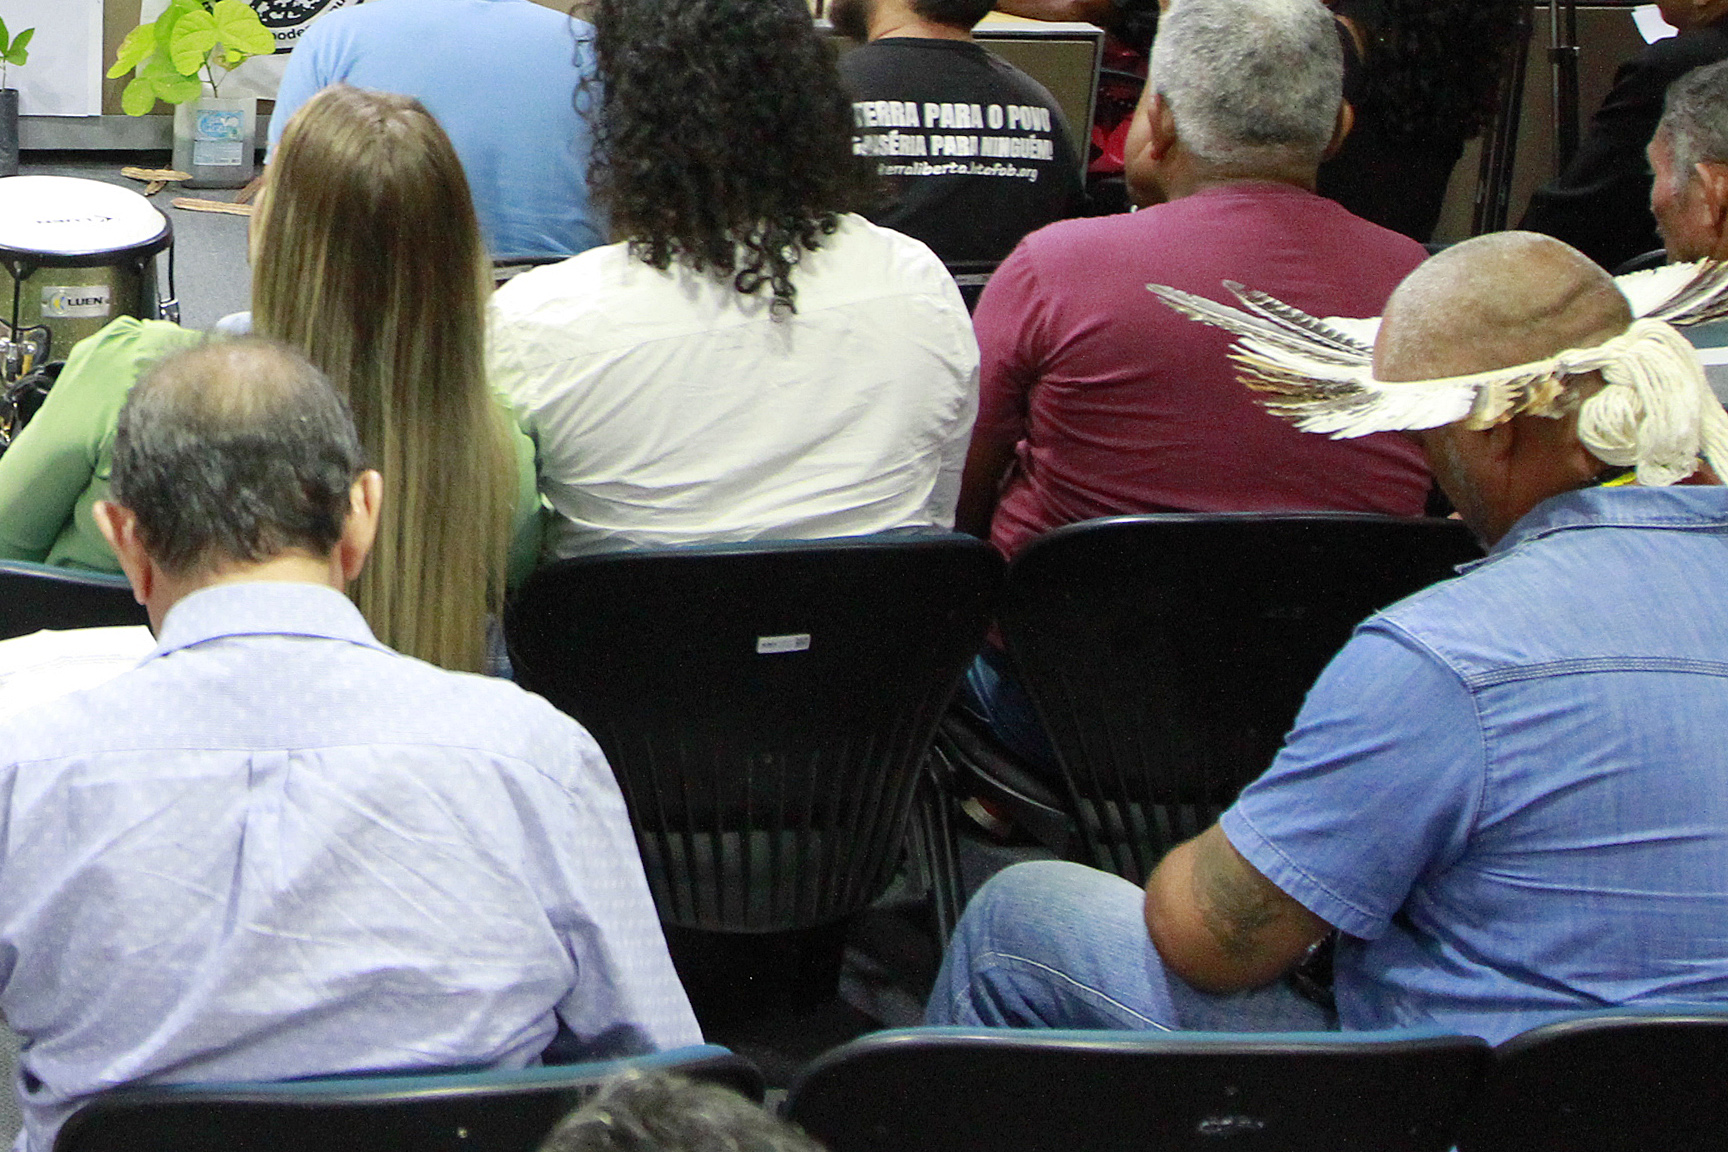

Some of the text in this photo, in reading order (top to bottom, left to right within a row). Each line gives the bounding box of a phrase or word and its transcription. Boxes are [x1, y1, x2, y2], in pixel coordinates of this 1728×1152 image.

[851, 100, 921, 128] TERRA
[924, 102, 984, 129] PARA
[987, 103, 1004, 130] O
[67, 296, 103, 307] LUEN
